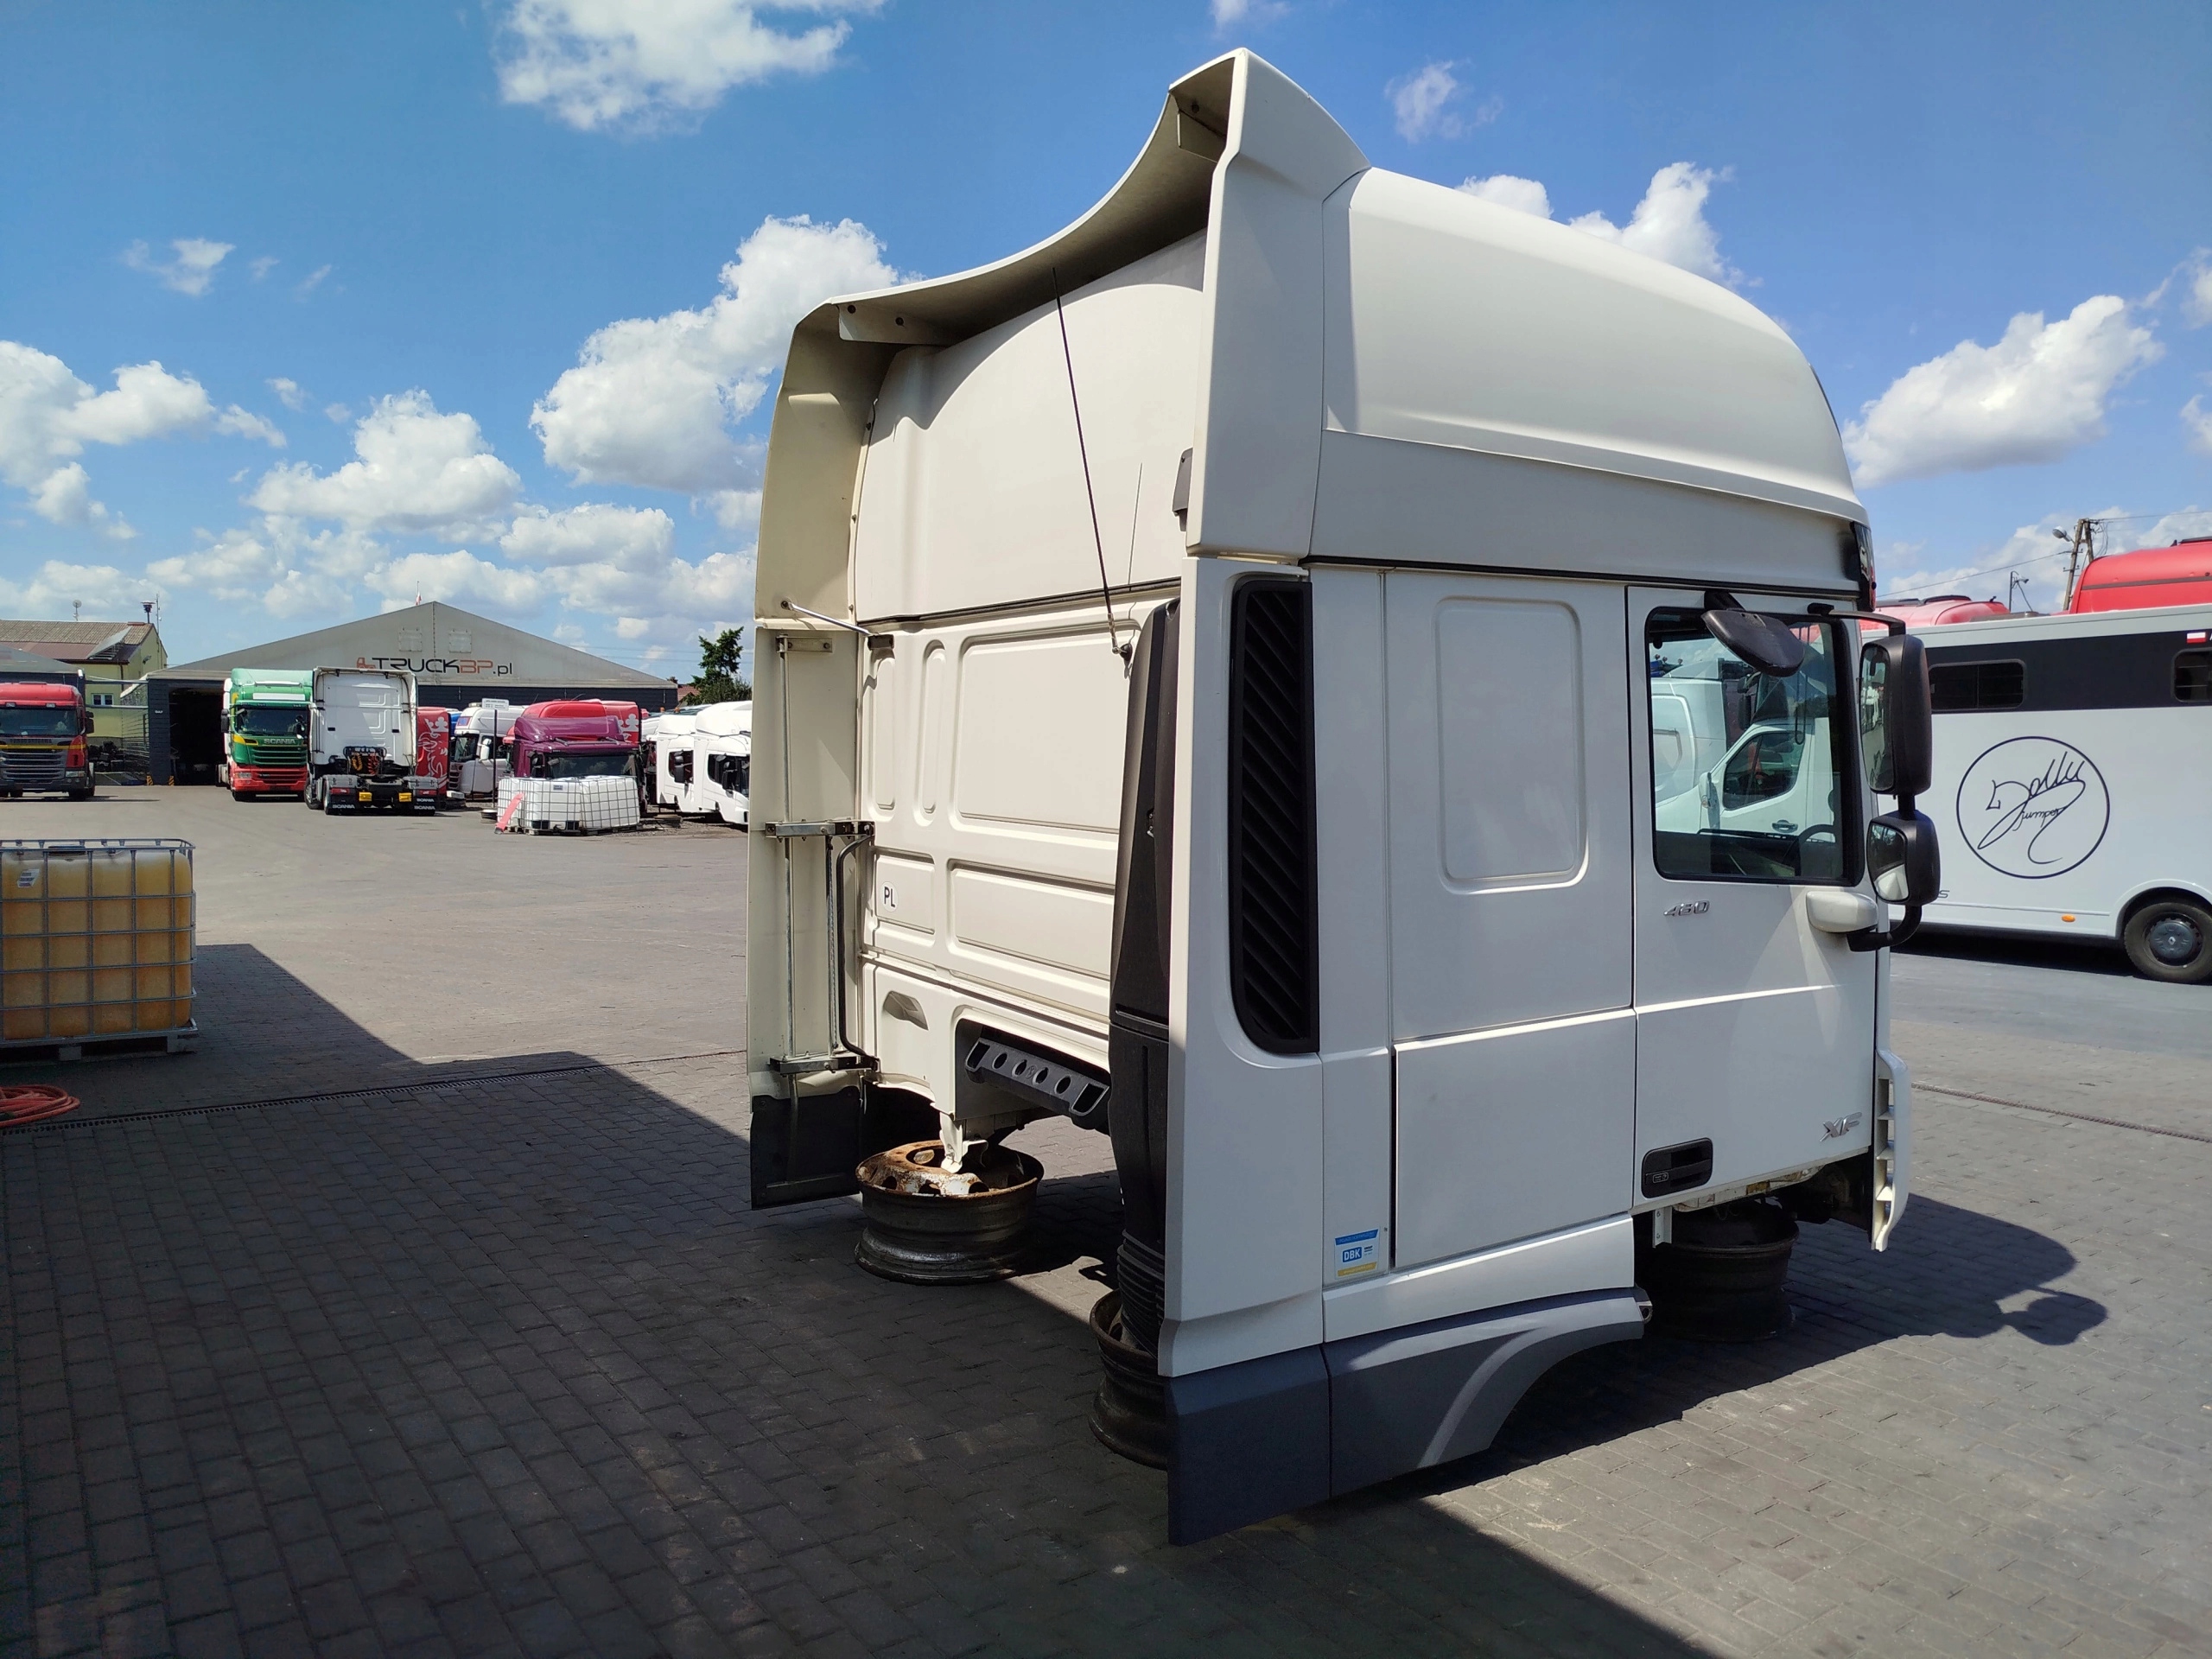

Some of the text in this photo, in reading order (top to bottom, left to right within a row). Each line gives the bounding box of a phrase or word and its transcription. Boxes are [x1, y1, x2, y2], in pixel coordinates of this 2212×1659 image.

[884, 886, 896, 908] PL
[1820, 1111, 1863, 1142] XF
[1344, 1247, 1362, 1262] DBK
